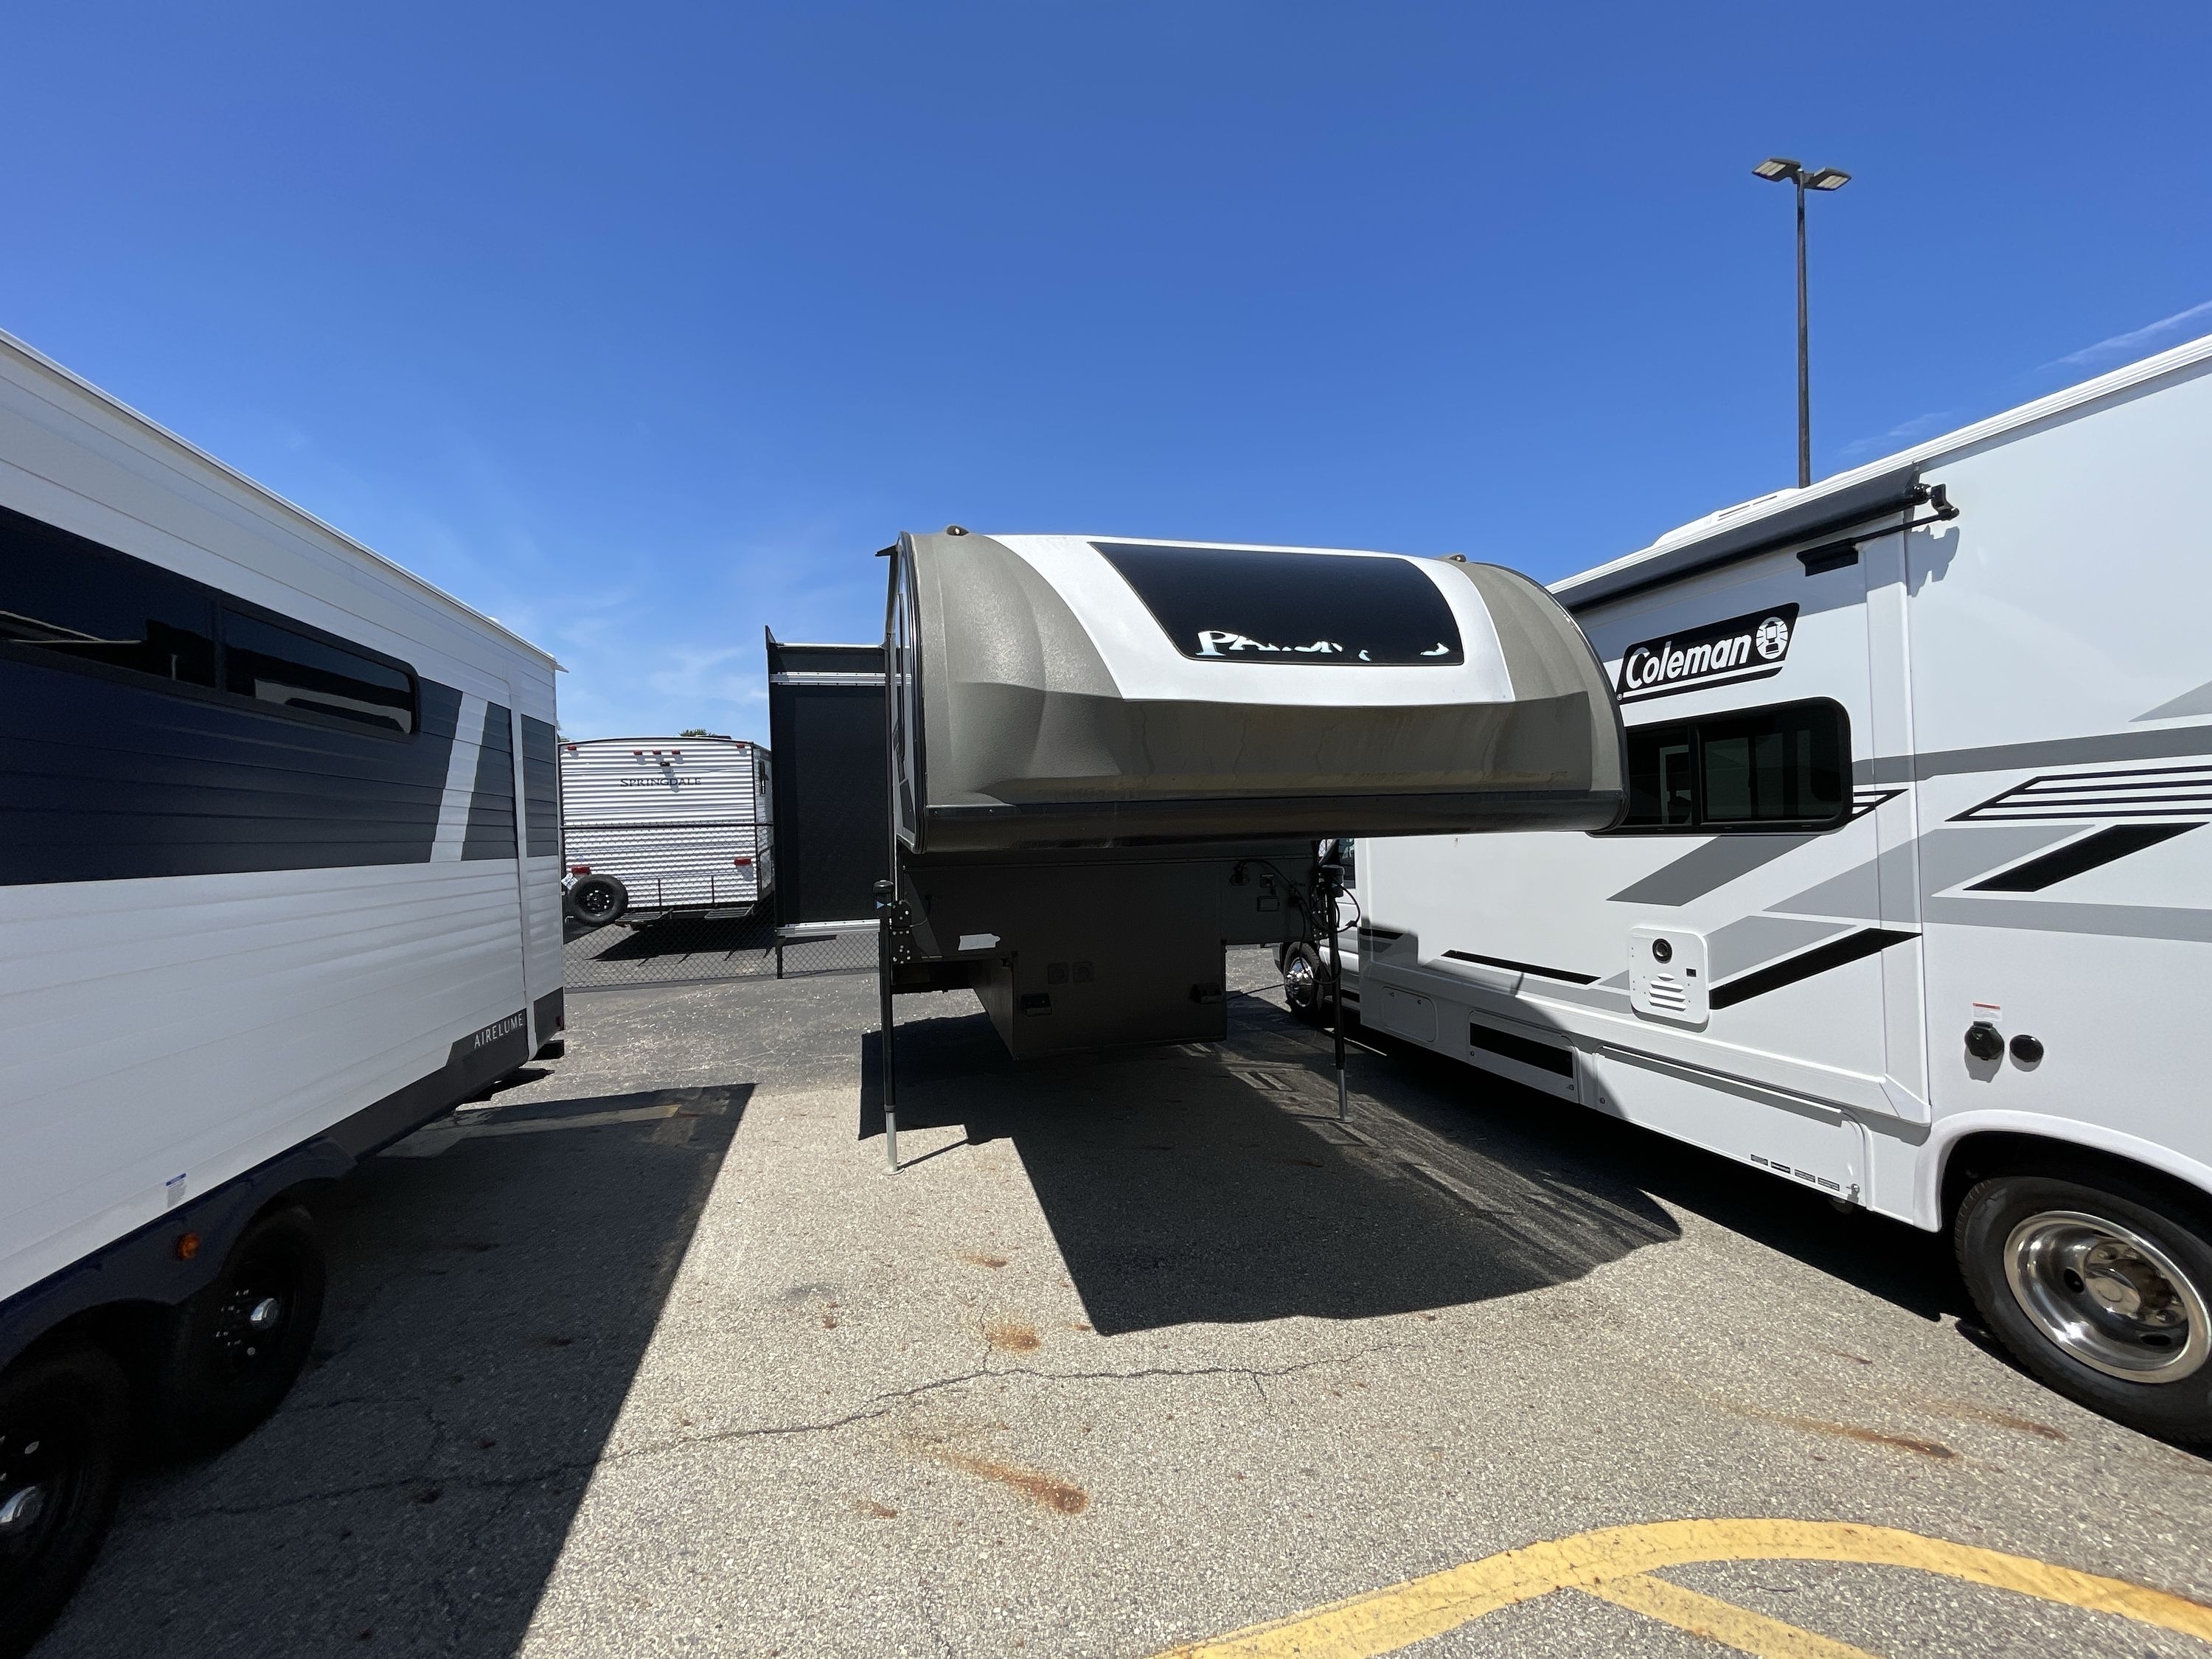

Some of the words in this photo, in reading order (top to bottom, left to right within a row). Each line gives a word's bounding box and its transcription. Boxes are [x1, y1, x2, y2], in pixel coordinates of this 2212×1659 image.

[1626, 634, 1752, 689] Coleman
[619, 777, 702, 787] SPRINGDALE
[473, 1013, 524, 1049] AIRELUME
